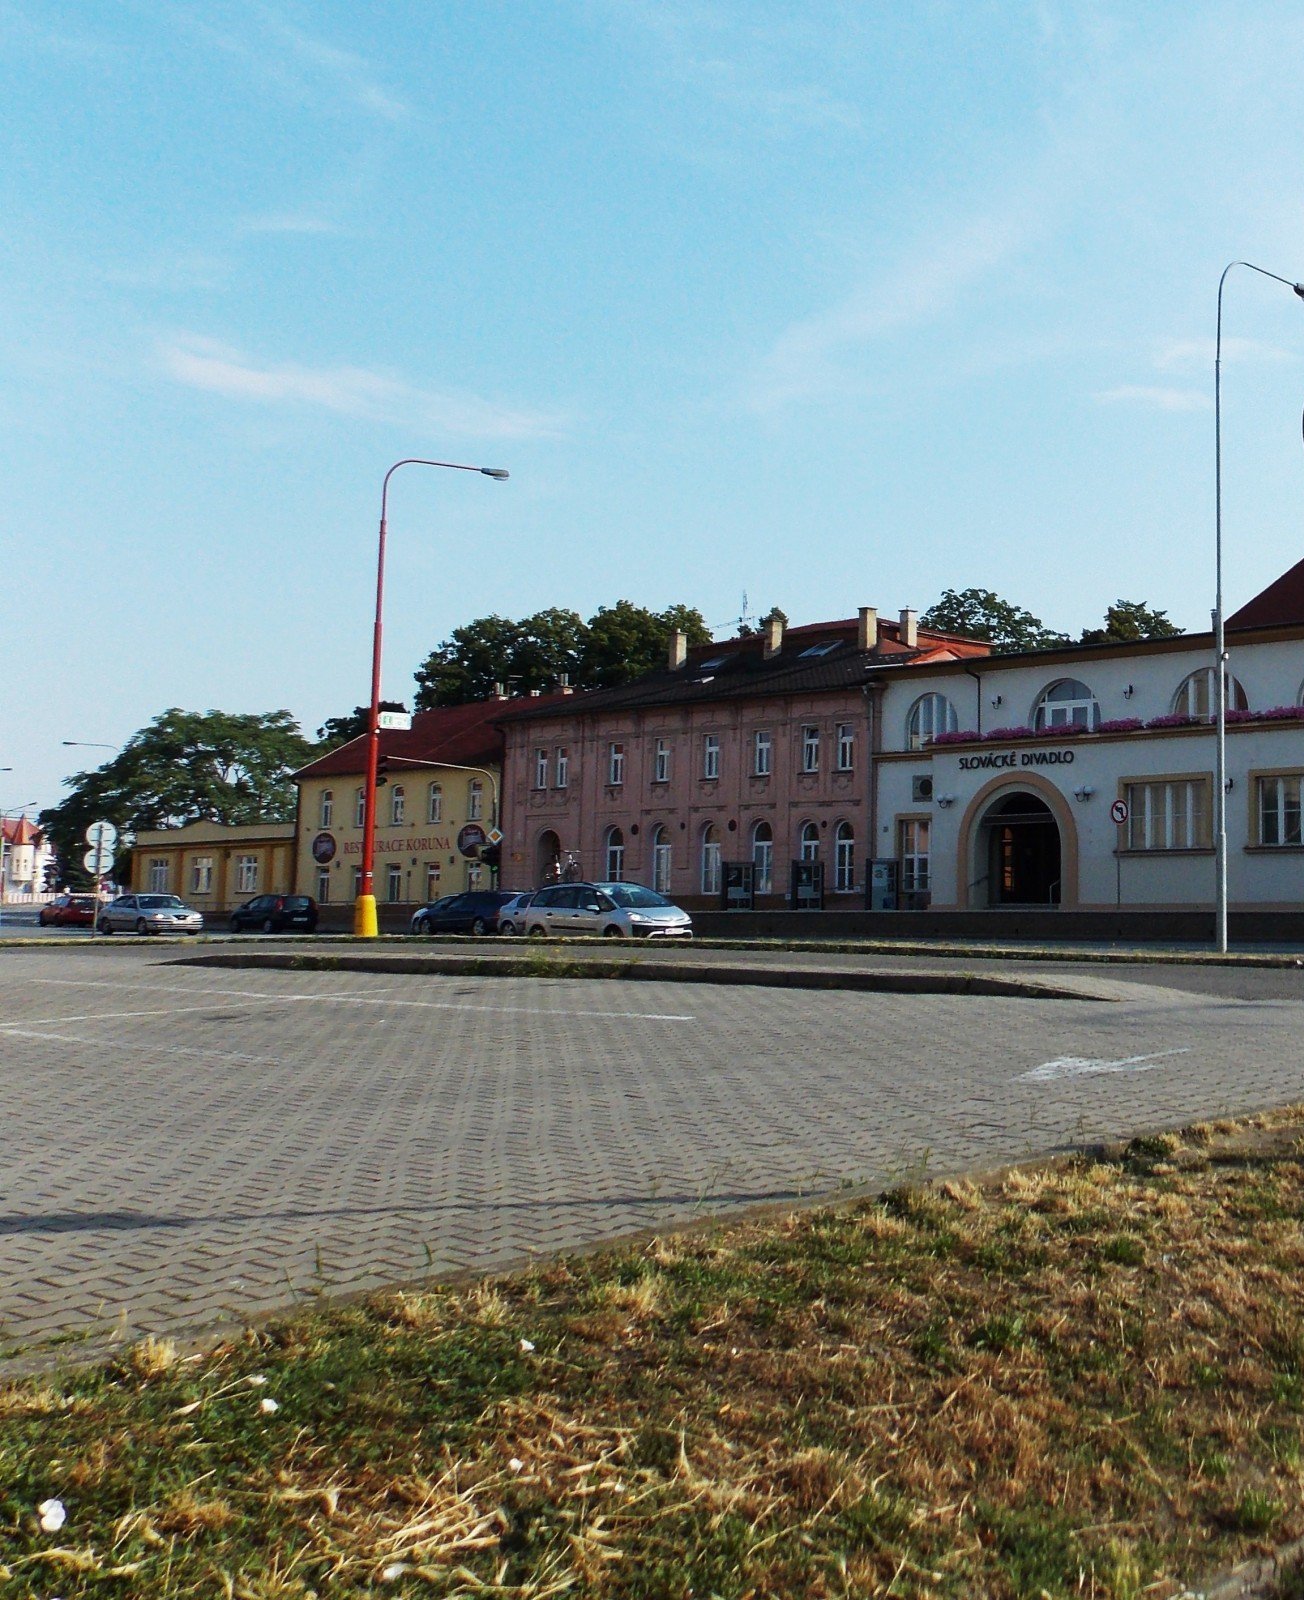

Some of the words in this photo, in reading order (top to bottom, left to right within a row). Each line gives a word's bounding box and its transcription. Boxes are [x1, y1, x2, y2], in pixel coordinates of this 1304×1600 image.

[958, 751, 1016, 770] SLOVÁCKÉ
[1021, 751, 1075, 766] DIVADLO
[406, 837, 451, 852] KORUNA
